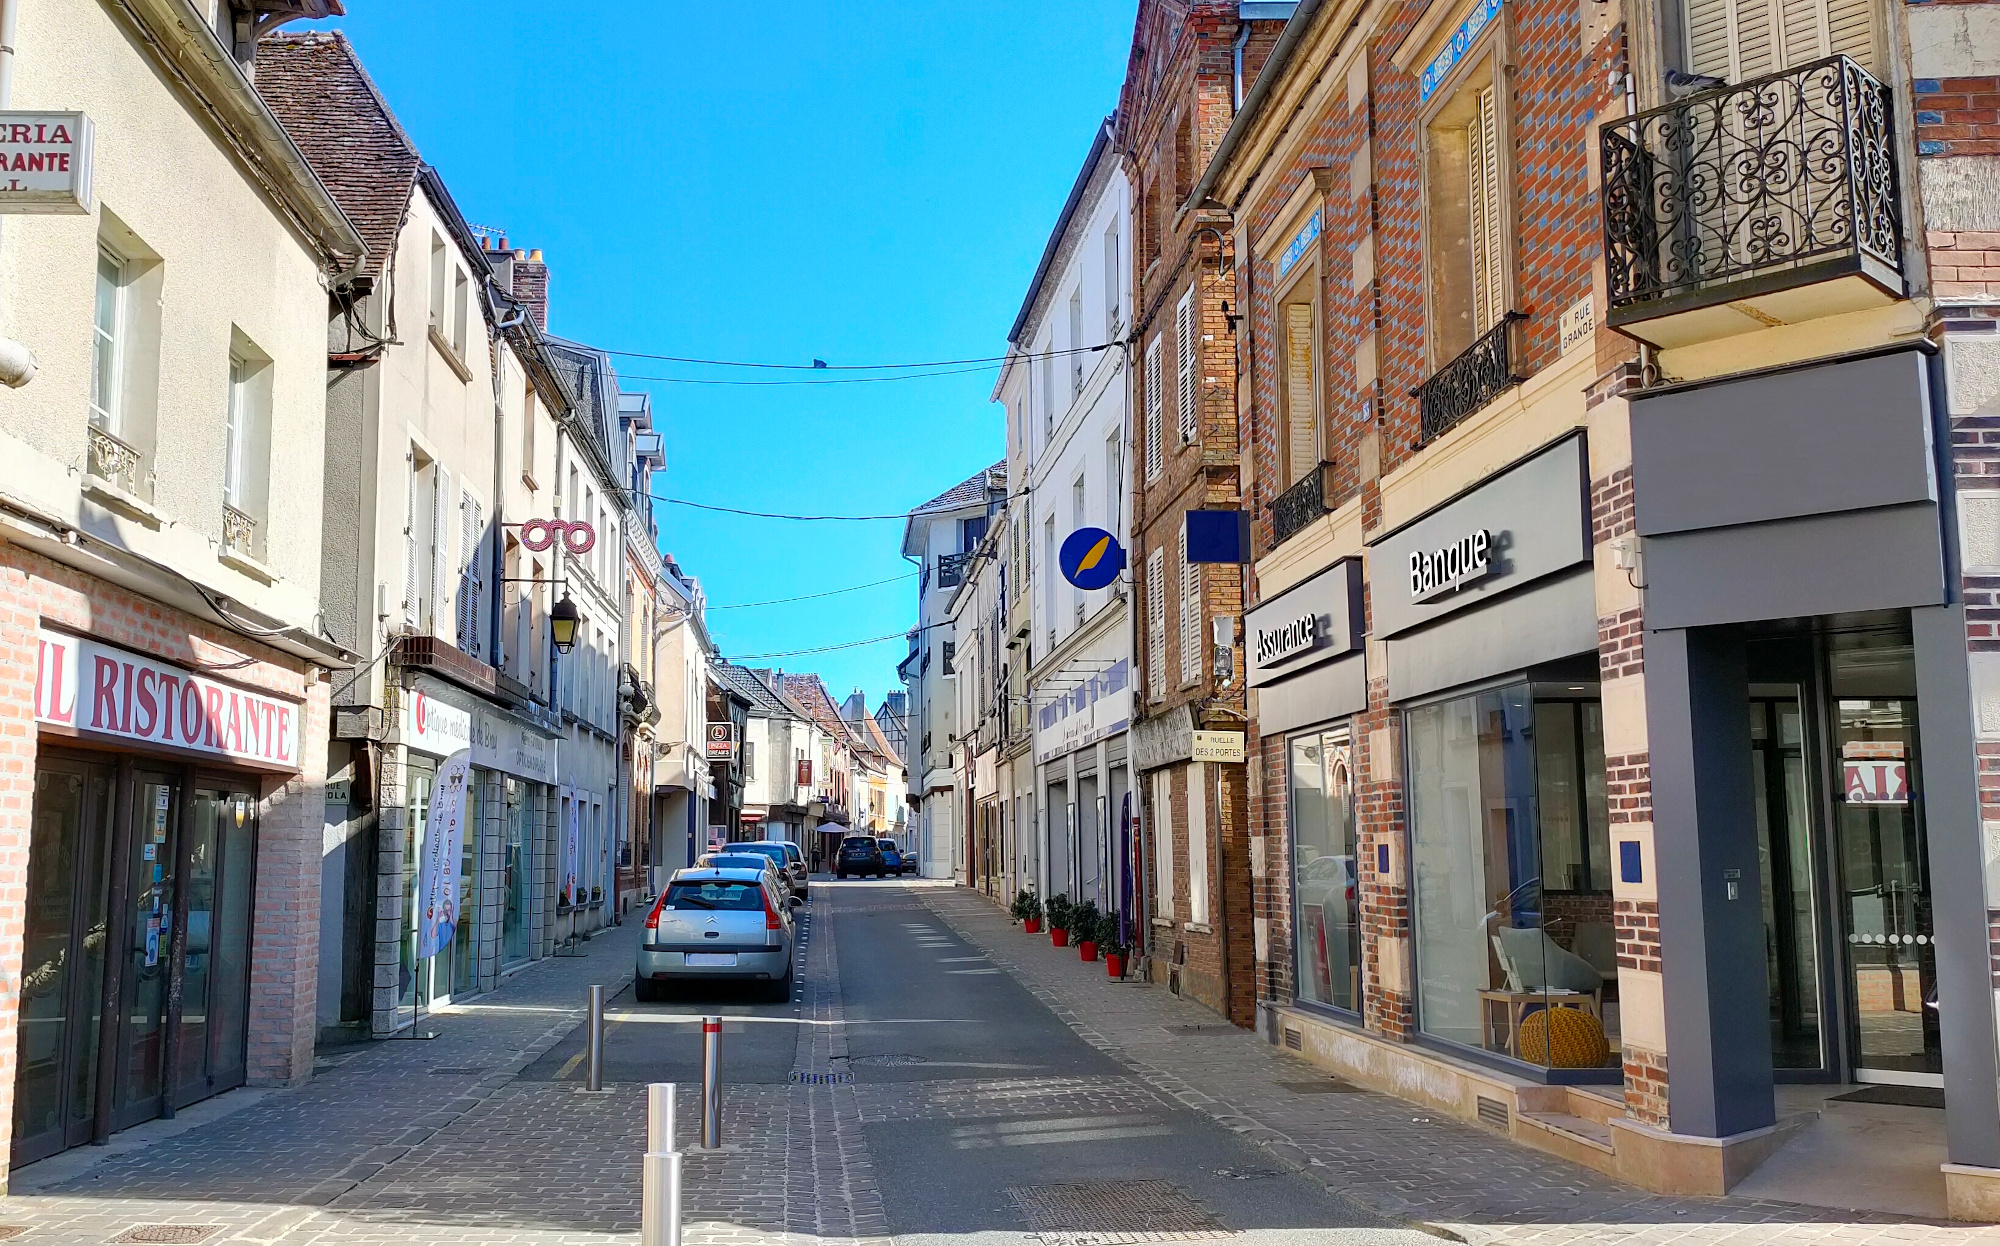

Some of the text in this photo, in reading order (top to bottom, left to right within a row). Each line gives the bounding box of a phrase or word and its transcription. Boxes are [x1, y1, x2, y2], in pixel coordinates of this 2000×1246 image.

[1574, 303, 1590, 324] RUE
[1563, 318, 1594, 348] GRANDE
[1409, 529, 1490, 597] Banque
[1256, 613, 1315, 663] Assurance
[90, 654, 290, 761] RISTORANTE
[477, 718, 483, 747] de
[485, 722, 497, 758] Bray
[1196, 748, 1241, 757] DES 2 PORTES
[325, 791, 347, 799] OLA
